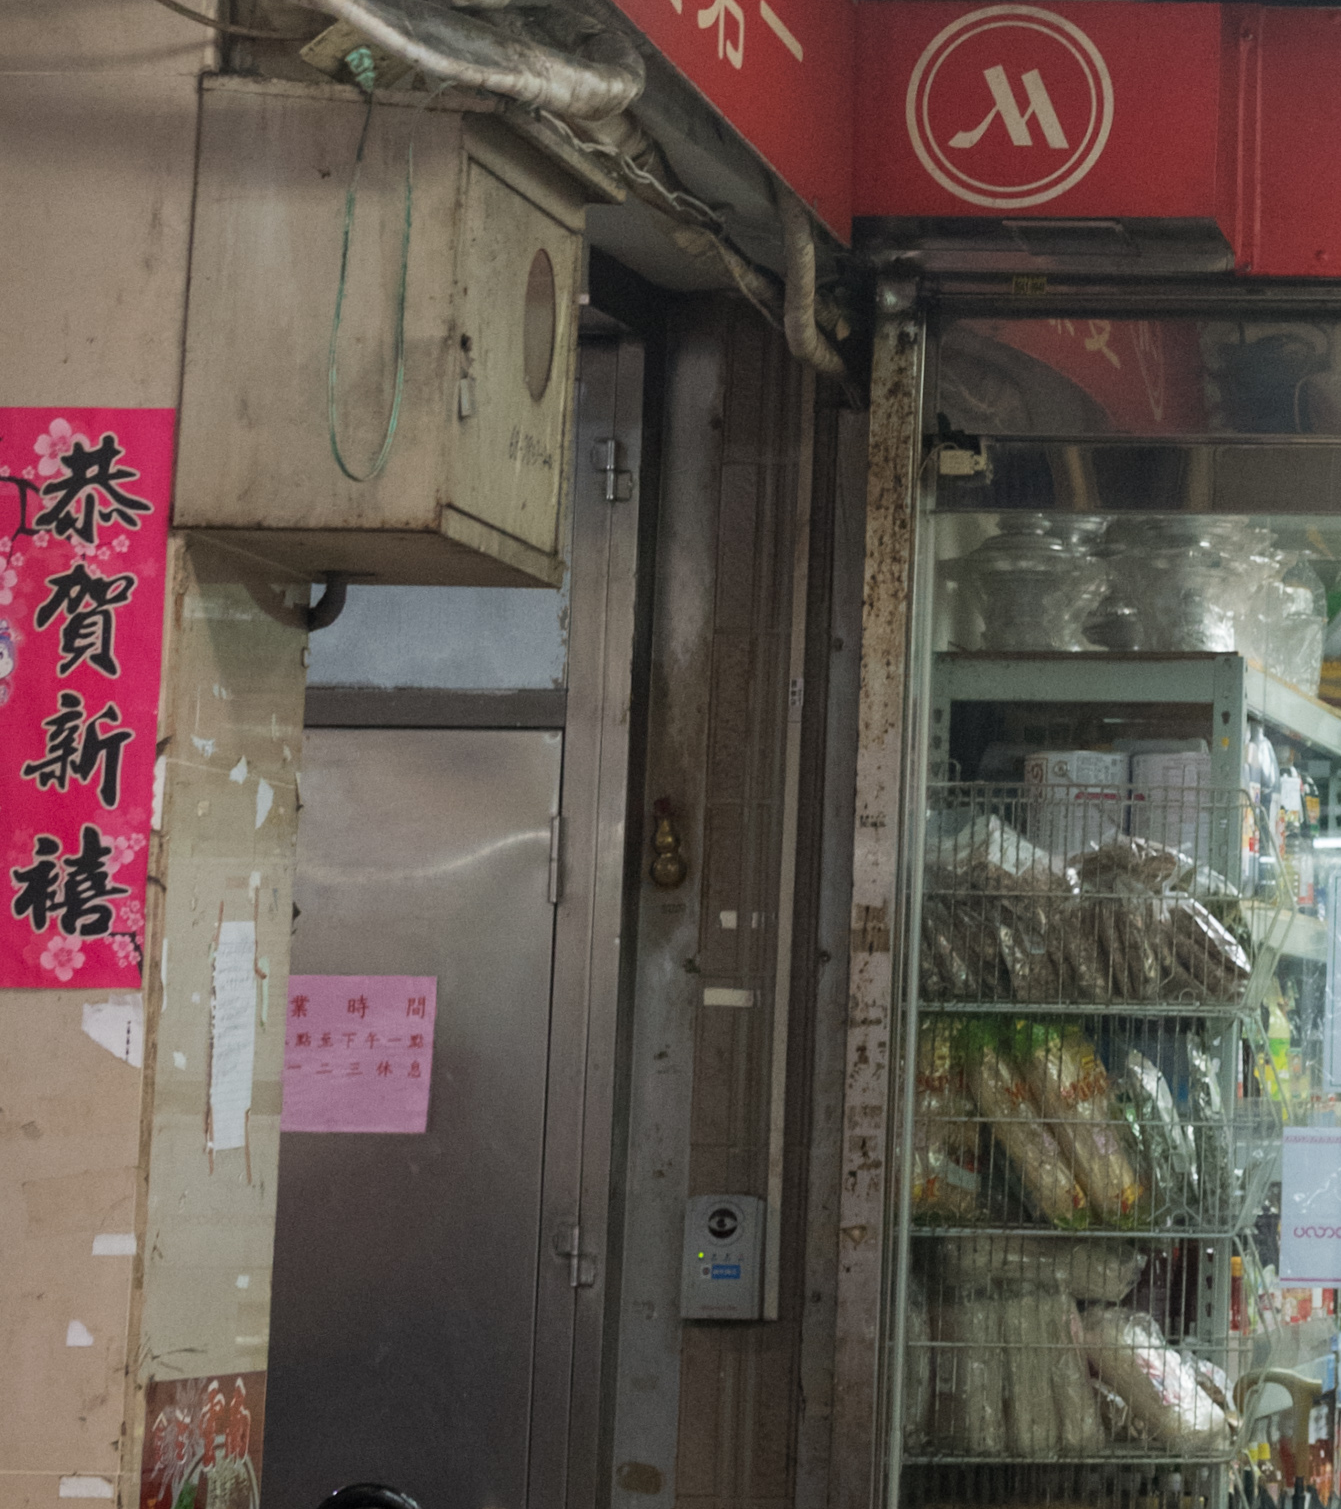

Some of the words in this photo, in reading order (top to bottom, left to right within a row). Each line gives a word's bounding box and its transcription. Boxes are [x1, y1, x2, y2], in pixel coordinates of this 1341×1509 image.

[11, 435, 152, 937] 恭賀新禧
[285, 1032, 424, 1049] 點至下午一點
